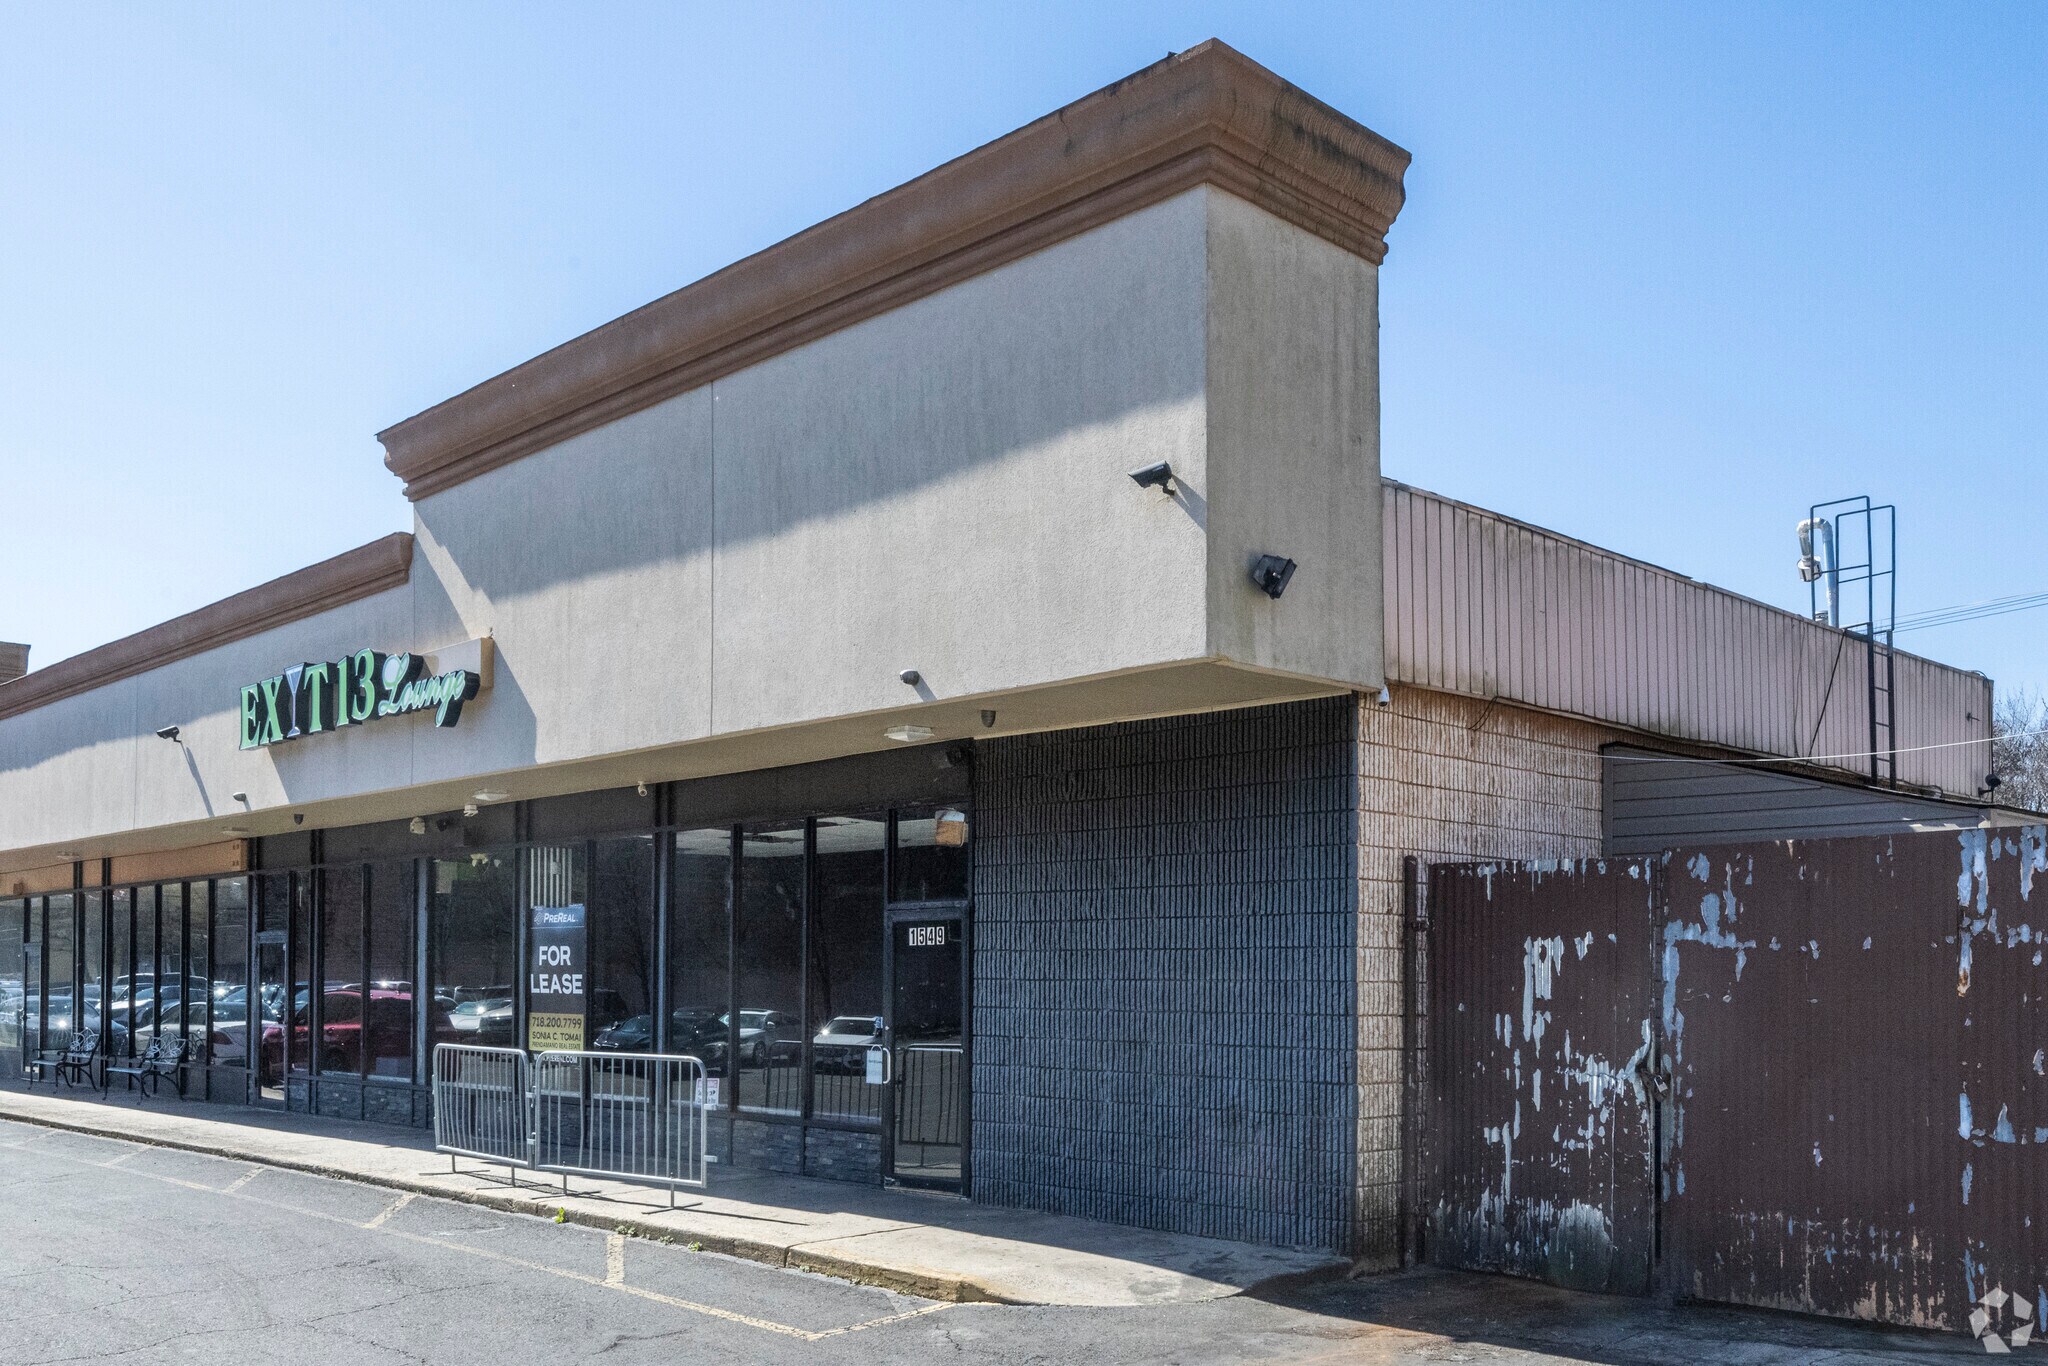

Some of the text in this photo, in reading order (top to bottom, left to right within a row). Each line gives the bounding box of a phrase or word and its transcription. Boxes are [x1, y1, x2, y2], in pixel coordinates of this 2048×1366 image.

[336, 647, 376, 728] 13
[377, 651, 467, 728] Lounge
[909, 926, 944, 945] 1549
[538, 945, 572, 967] FOR
[530, 973, 584, 995] LEASE
[532, 1016, 582, 1029] 718.200.7799
[532, 1031, 551, 1040] SONIA
[560, 1033, 582, 1042] TOMAI
